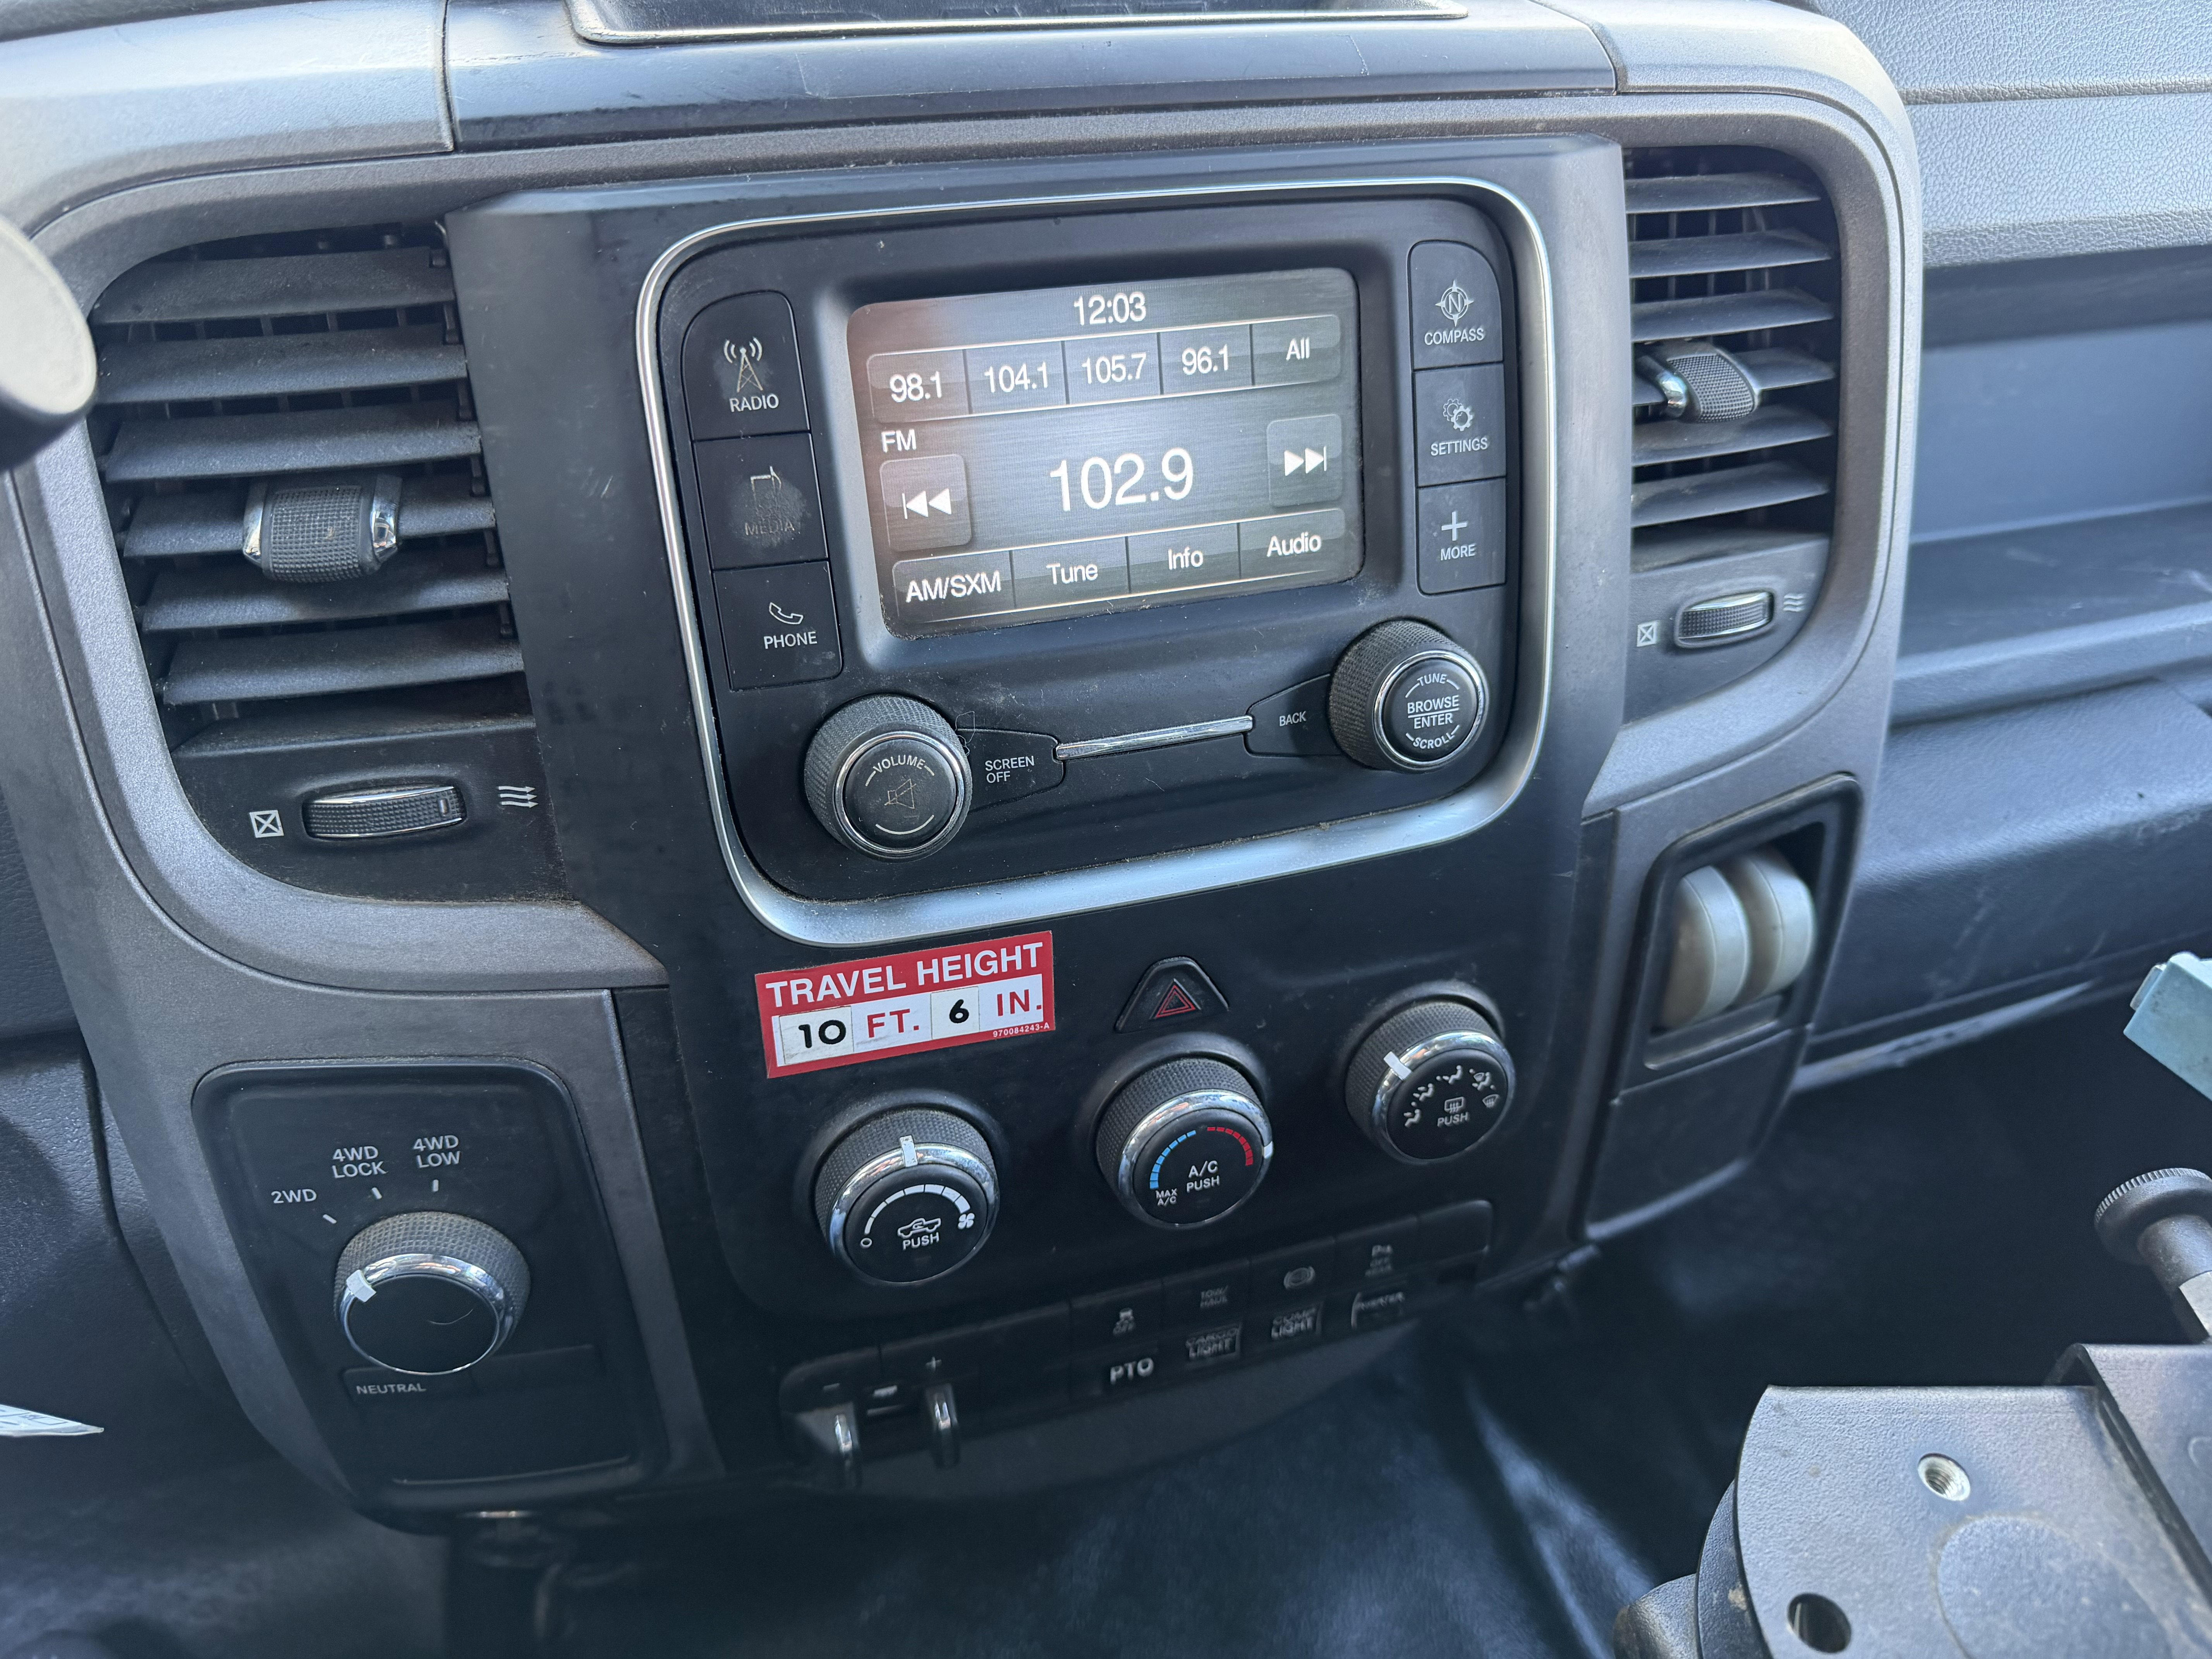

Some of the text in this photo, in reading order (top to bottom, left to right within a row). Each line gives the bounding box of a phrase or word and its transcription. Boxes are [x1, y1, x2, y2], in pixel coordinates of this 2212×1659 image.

[1074, 291, 1146, 326] 12:03
[1448, 293, 1461, 313] N
[1424, 328, 1484, 345] COMPASS
[1286, 338, 1310, 361] All
[1083, 353, 1147, 385] 105.7
[1182, 345, 1229, 376] 96.1
[890, 371, 943, 402] 98.1
[985, 362, 1049, 394] 104.1
[730, 394, 779, 412] RADIO
[882, 430, 916, 452] FM
[1431, 438, 1488, 457] SETTINGS
[1050, 448, 1194, 512] 102.9
[745, 521, 795, 536] MEDIA
[1267, 532, 1321, 557] Audio
[1440, 544, 1476, 561] MORE
[1168, 547, 1204, 571] Info
[1046, 562, 1098, 584] Tune
[906, 571, 1002, 603] AM/SXM
[764, 632, 817, 649] PHONE
[1417, 673, 1447, 687] TUNE
[1407, 695, 1459, 714] BROWSE
[1279, 711, 1306, 727] BACK
[1413, 713, 1453, 729] ENTER
[1412, 733, 1455, 749] SCROLL
[873, 754, 926, 773] VOLUME
[985, 756, 1034, 772] SCREEN
[986, 771, 1011, 783] OFF
[766, 942, 1043, 1008] TRAVEL HEIGHT
[798, 989, 1042, 1049] 10 FT. 6 IN.
[993, 1022, 1050, 1038] 970084243-A
[1437, 1111, 1469, 1127] PUSH
[412, 1135, 459, 1152] 4WD
[332, 1146, 378, 1162] 4WD
[416, 1151, 461, 1169] LOW
[331, 1161, 387, 1179] LOCK
[1188, 1160, 1218, 1179] A/C
[1187, 1175, 1220, 1193] PUSH
[271, 1188, 317, 1204] 2WD
[1156, 1188, 1178, 1199] MAX
[1157, 1196, 1176, 1207] A/C
[903, 1233, 939, 1250] PUSH
[1110, 1357, 1154, 1385] PTO
[356, 1383, 426, 1394] NEUTRAL
